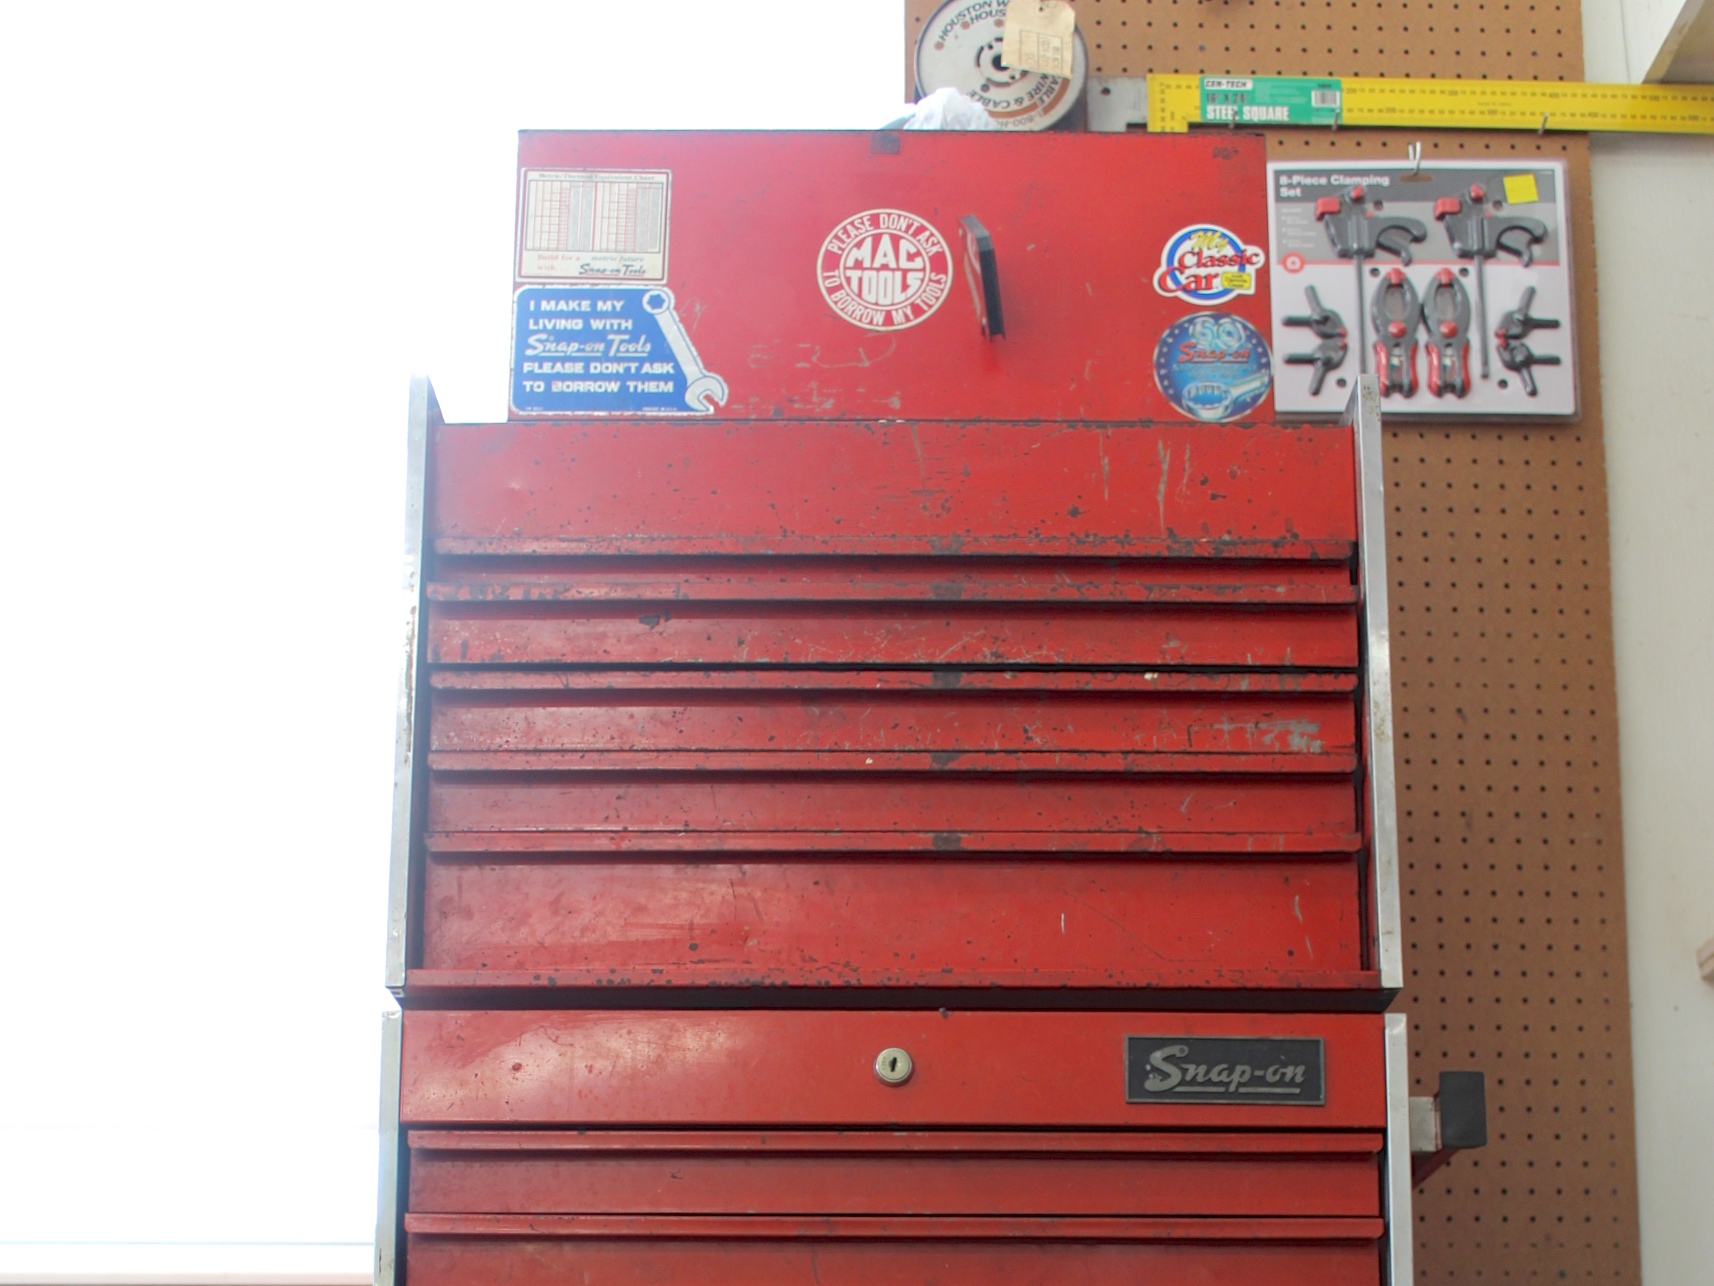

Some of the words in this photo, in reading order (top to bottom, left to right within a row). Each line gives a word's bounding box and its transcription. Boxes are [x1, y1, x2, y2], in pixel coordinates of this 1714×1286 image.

[939, 0, 992, 42] HOUSTON
[970, 9, 1006, 25] HOUS
[1038, 75, 1060, 105] ABLE
[1205, 80, 1247, 88] CEN-TECH
[1206, 105, 1240, 120] STEEL
[1243, 106, 1290, 121] SQUARE
[1279, 174, 1328, 186] 8-Piece
[1330, 174, 1391, 187] Clamping
[1279, 186, 1302, 198] Set
[827, 215, 874, 255] PLEASE
[879, 213, 921, 235] DON'T
[916, 231, 943, 257] ASK
[1190, 230, 1229, 253] My
[845, 234, 925, 270] MAC
[1178, 248, 1260, 269] Classic
[579, 263, 621, 276] Snap-on
[622, 264, 646, 276] Tools
[822, 269, 840, 288] TO
[1158, 266, 1219, 293] Car
[845, 269, 925, 305] TOOLS
[914, 272, 947, 312] TOOLS
[529, 300, 535, 312] I
[540, 300, 591, 312] MAKE
[596, 300, 626, 312] MY
[830, 289, 886, 326] BORROW
[891, 305, 915, 325] MY
[528, 318, 584, 330] LIVING
[590, 318, 633, 330] WITH
[525, 333, 606, 357] Snap-on
[607, 334, 652, 357] Tools
[1177, 339, 1251, 364] Snap-on
[523, 362, 584, 374] PLEASE
[589, 362, 639, 374] DON'T
[640, 362, 675, 374] ASK
[523, 381, 545, 393] TO
[552, 381, 621, 393] BORROW
[626, 381, 674, 393] THEM
[1144, 1045, 1306, 1094] Snap-on
